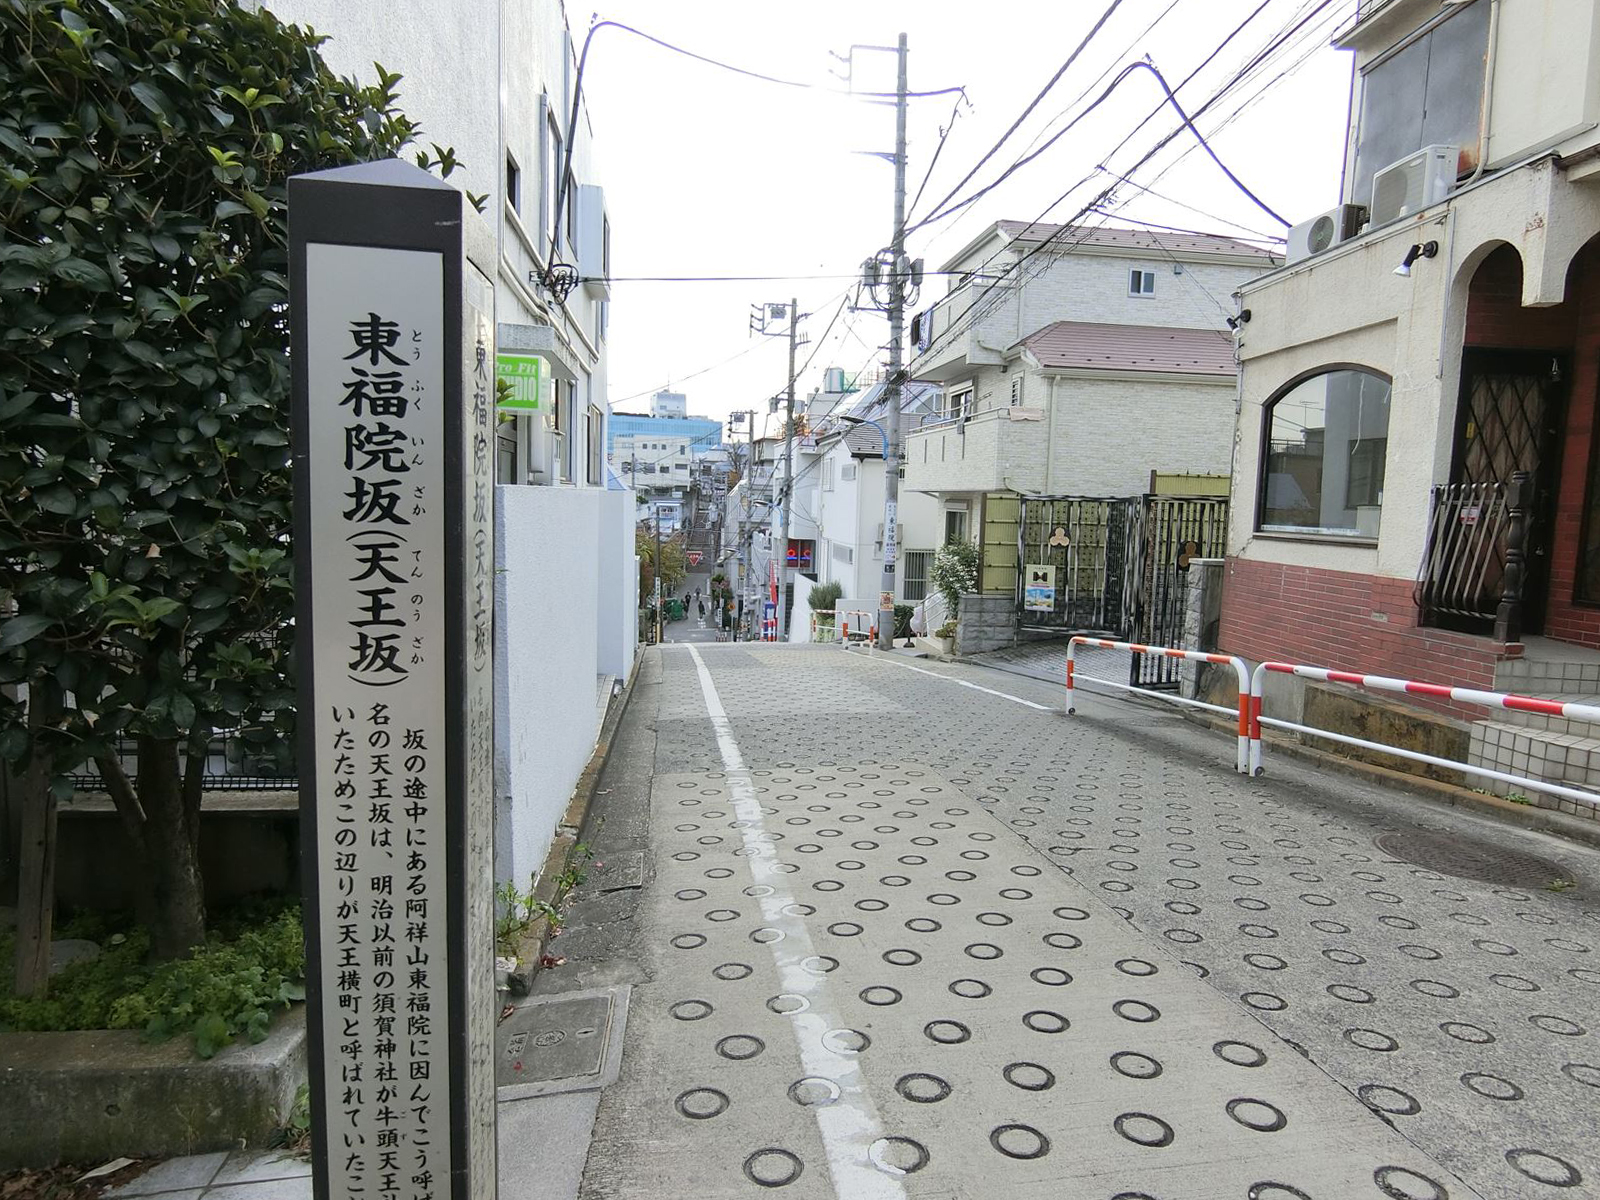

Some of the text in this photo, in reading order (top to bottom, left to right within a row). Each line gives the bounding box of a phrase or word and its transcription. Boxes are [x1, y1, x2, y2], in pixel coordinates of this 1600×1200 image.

[339, 312, 412, 687] 東福院坂(天王坂)
[331, 705, 366, 1200] いたためこの辺りが天王横町と呼ばれていたこ
